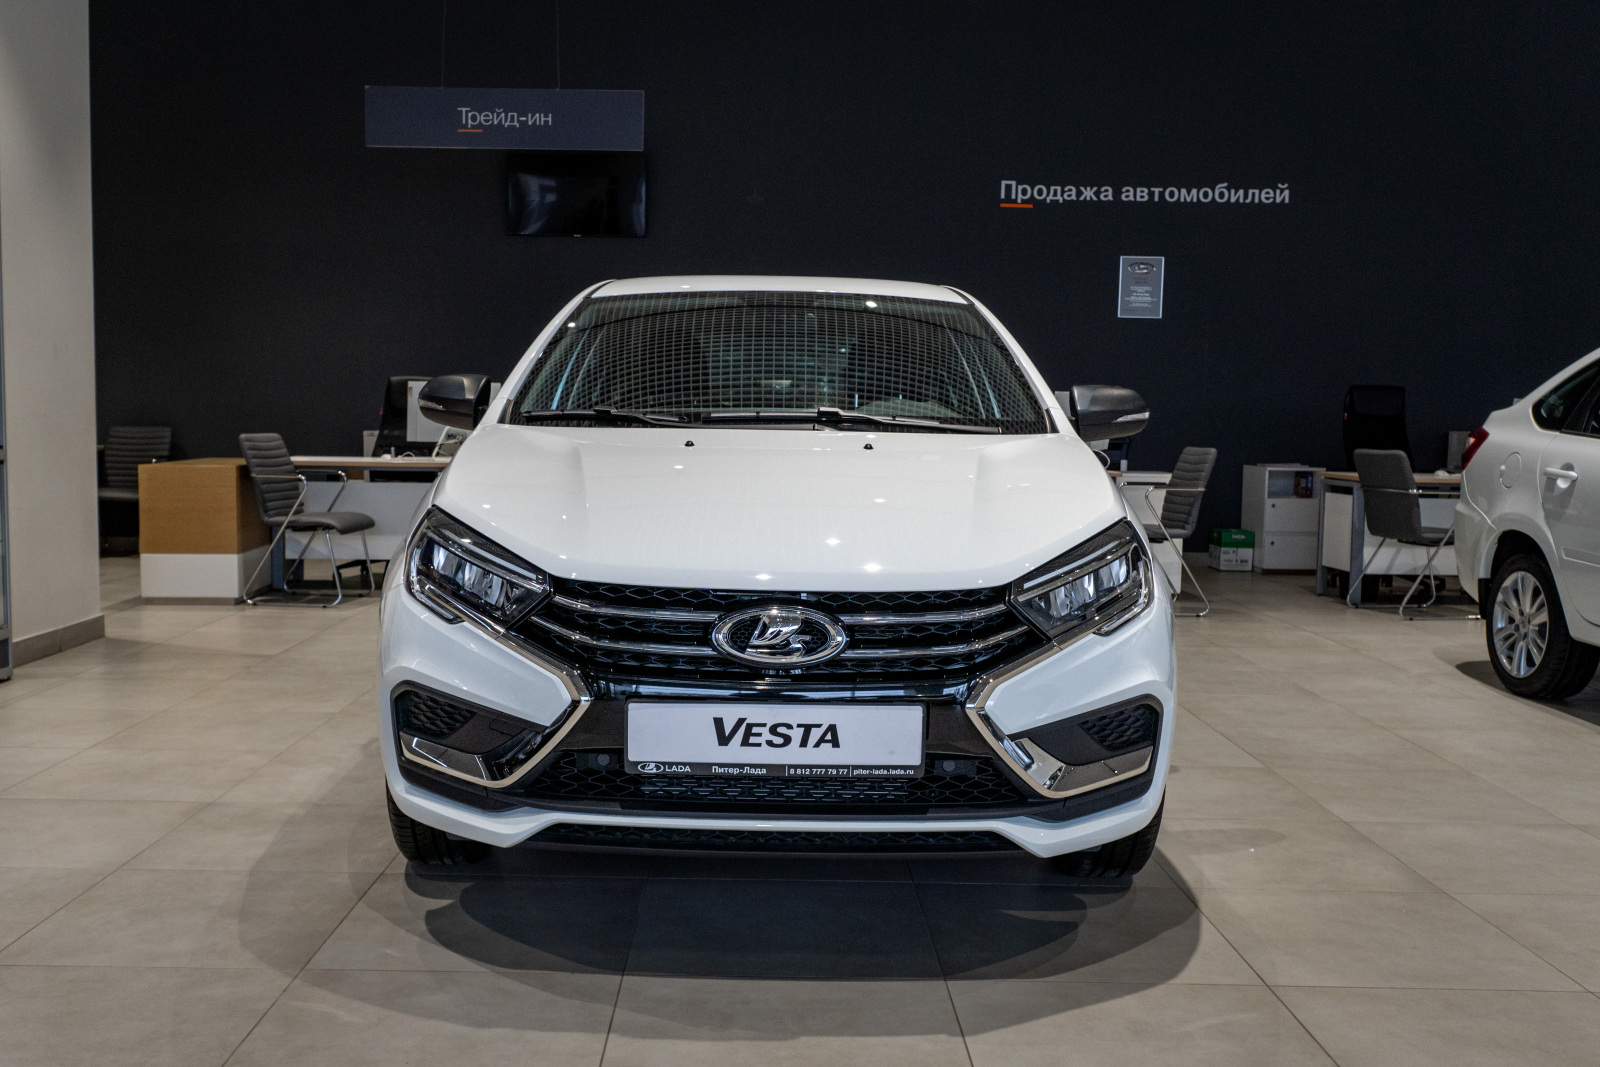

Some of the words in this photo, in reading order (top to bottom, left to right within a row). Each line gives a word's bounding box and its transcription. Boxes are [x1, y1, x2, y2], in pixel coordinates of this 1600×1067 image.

[457, 107, 552, 128] Трейд-ин
[1000, 180, 1113, 203] Продажа
[1121, 183, 1290, 204] автомобилей
[712, 717, 841, 749] VESTA
[665, 764, 691, 773] LADA
[711, 765, 767, 775] Питер-Лада
[853, 767, 915, 776] piter-lada.lada.ru
